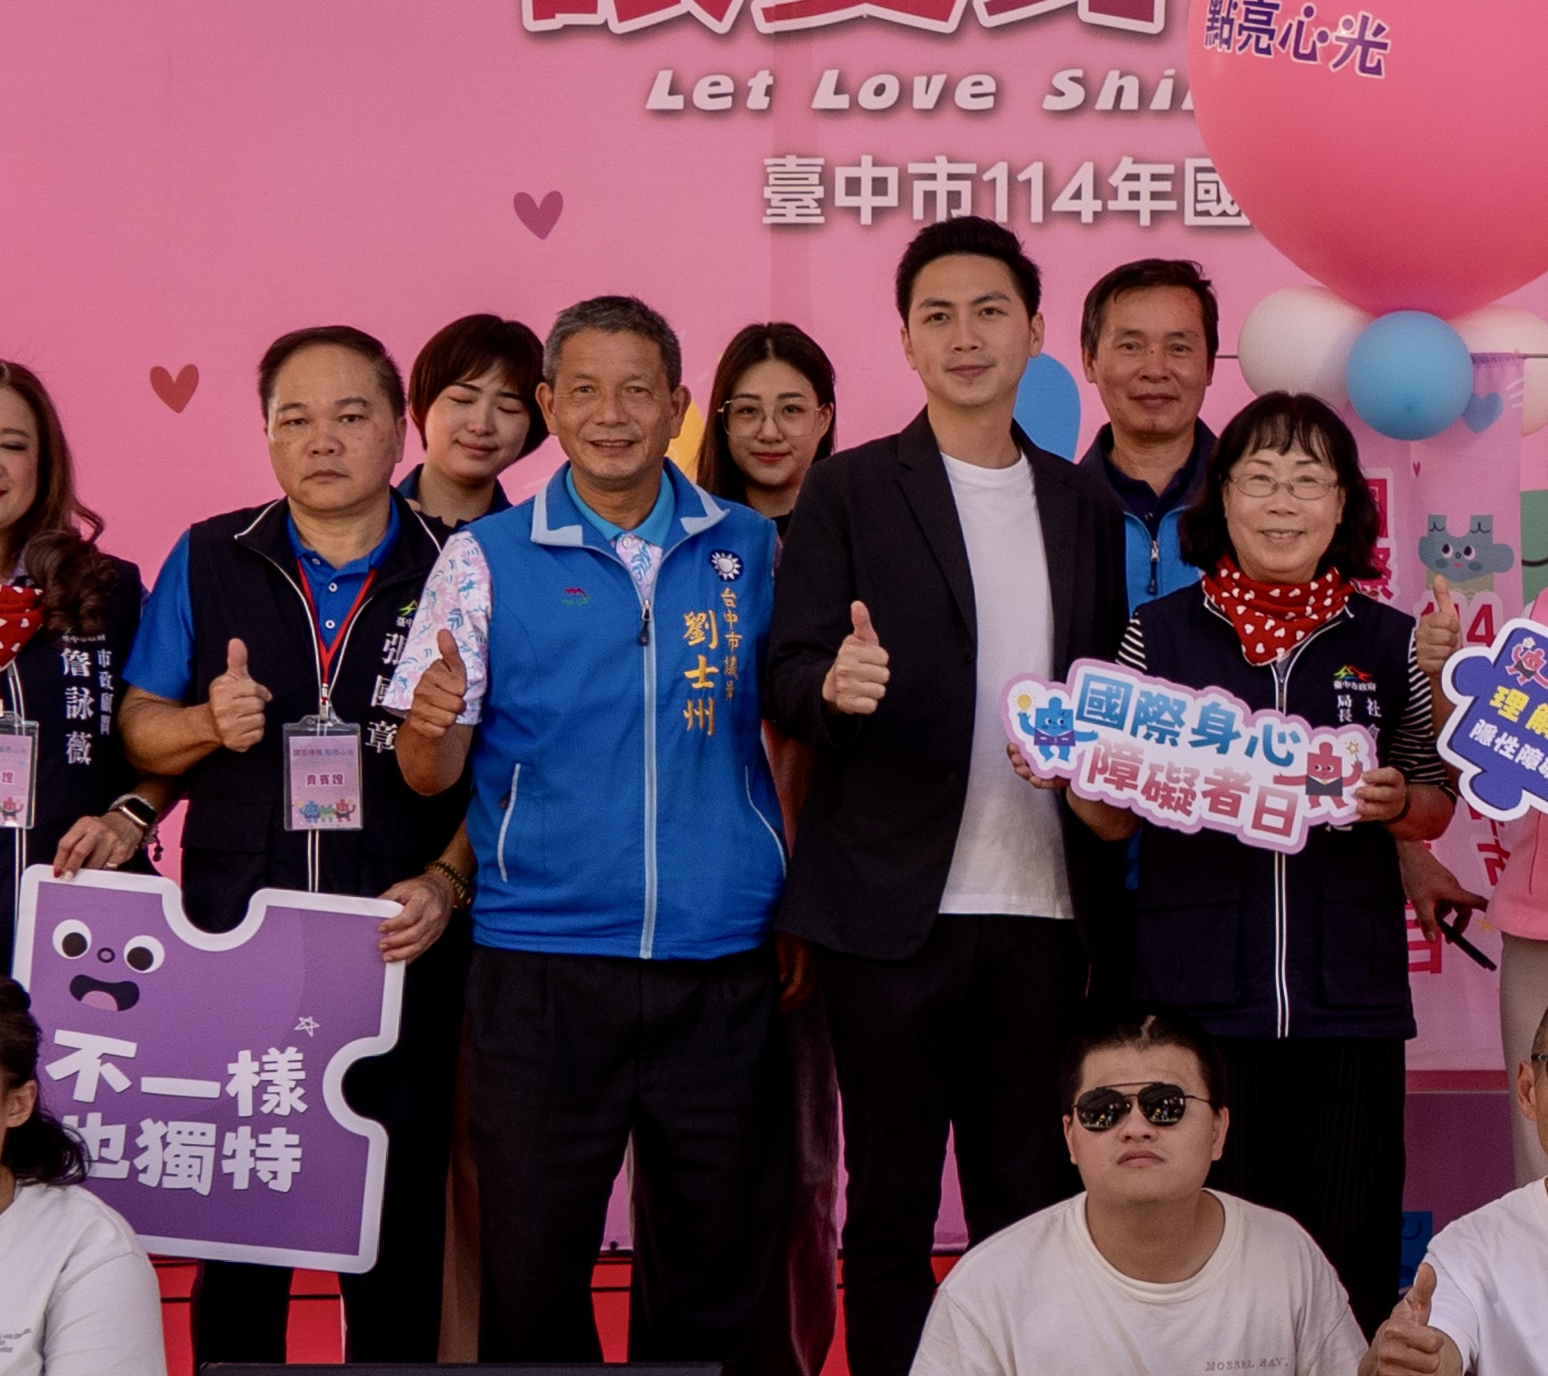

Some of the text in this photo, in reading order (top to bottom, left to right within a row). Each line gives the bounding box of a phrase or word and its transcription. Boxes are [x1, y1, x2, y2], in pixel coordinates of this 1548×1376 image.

[645, 69, 773, 112] Let
[812, 69, 998, 111] Love
[683, 609, 720, 737] 劉士州
[1076, 673, 1301, 768] 國際身心
[1086, 740, 1299, 838] 障礙者日
[45, 1028, 308, 1118] 不一樣
[60, 1111, 303, 1197] 也獨特
